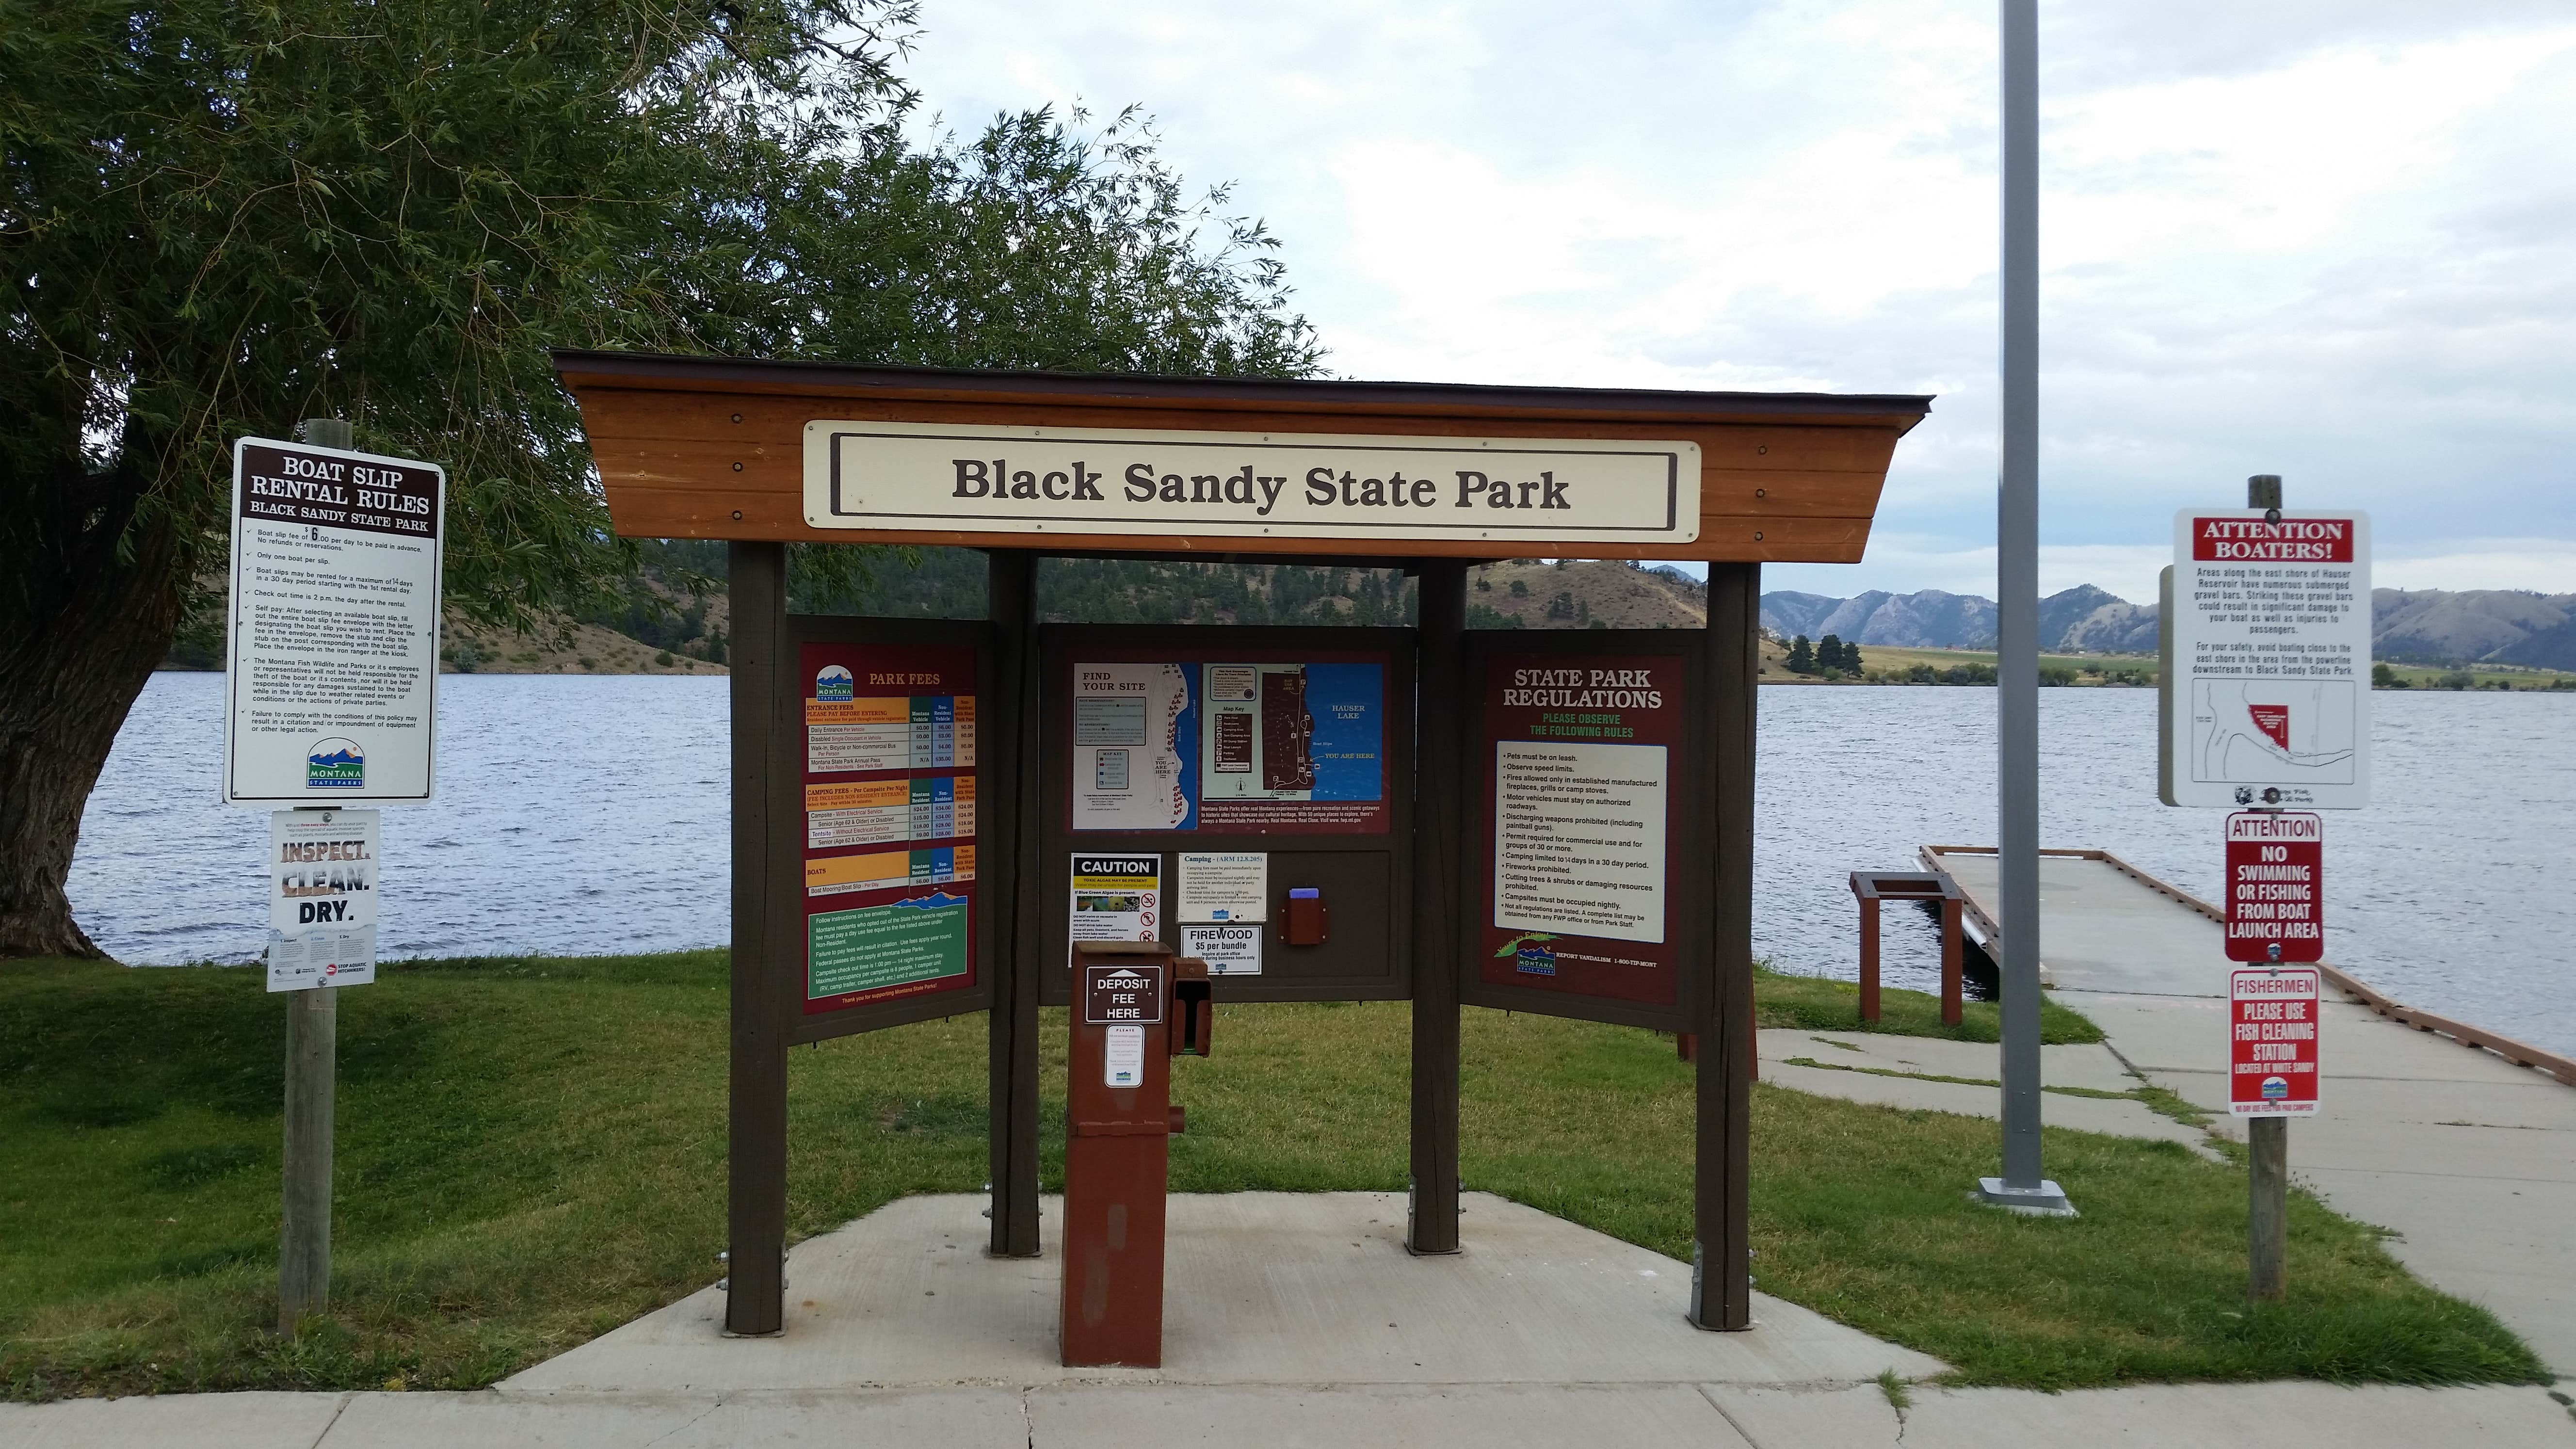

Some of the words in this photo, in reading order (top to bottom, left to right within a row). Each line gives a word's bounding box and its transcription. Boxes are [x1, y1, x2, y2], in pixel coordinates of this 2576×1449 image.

[283, 456, 344, 482] BOAT
[354, 467, 402, 489] SLIP
[952, 459, 1104, 500] Black
[1124, 464, 1287, 514] Sandy
[1305, 467, 1436, 507] State
[1455, 471, 1570, 509] Park
[251, 475, 348, 505] RENTAL
[357, 489, 429, 515] RULES
[250, 500, 296, 516] BLACK
[301, 507, 347, 522] SANDY
[352, 513, 390, 527] STATE
[395, 518, 428, 531] PARK
[2204, 521, 2343, 540] ATTENTION
[258, 529, 273, 539] Boat
[275, 531, 286, 540] slip
[343, 538, 354, 547] day
[397, 545, 422, 553] advance.
[269, 538, 293, 547] refunds
[304, 543, 343, 551] reservations.
[257, 551, 272, 560] Only
[2216, 542, 2332, 559] BOATERS!
[2197, 568, 2220, 577] Areas
[2224, 568, 2245, 578] along
[2249, 568, 2261, 578] the
[2265, 569, 2282, 578] east
[2286, 569, 2308, 578] shore
[2311, 569, 2319, 578] of
[2322, 569, 2351, 579] Hauser
[870, 674, 905, 684] PARK
[909, 674, 939, 684] FEES
[1082, 672, 1111, 680] FIND
[1515, 669, 1582, 687] STATE
[1590, 670, 1651, 688] PARK
[1082, 682, 1115, 691] YOUR
[1119, 682, 1145, 691] SITE
[1504, 689, 1661, 708] REGULATIONS
[1544, 713, 1575, 724] PLEASE
[1579, 713, 1620, 724] OBSERVE
[1530, 725, 1546, 735] THE
[1550, 725, 1601, 737] FOLLOWING
[1604, 727, 1633, 738] RULES
[1507, 763, 1533, 771] Observe
[2233, 819, 2315, 837] ATTENTION
[281, 840, 370, 863] INSPECT.
[2262, 846, 2287, 862] NO
[1082, 861, 1149, 872] CAUTION
[1505, 862, 1536, 871] Fireworks
[1537, 866, 1571, 874] prohibited.
[2238, 865, 2310, 881] SWIMMING
[282, 869, 369, 898] CLEAN.
[2237, 884, 2255, 900] OR
[2259, 884, 2310, 900] FISHING
[1505, 892, 1538, 902] Campsites
[1566, 899, 1595, 907] occupied
[1597, 901, 1621, 910] nightly.
[300, 900, 354, 924] DRY.
[2238, 903, 2274, 919] FROM
[2278, 903, 2311, 919] BOAT
[1191, 930, 1252, 940] FIREWOOD
[2229, 922, 2281, 938] LAUNCH
[2285, 922, 2319, 938] AREA
[1195, 942, 1205, 951] $5
[1207, 943, 1220, 952] per
[1222, 941, 1247, 950] bundle
[1519, 960, 1554, 968] MONTANA
[1579, 954, 1611, 963] VANDALISM
[1614, 958, 1657, 968] 1-800-TIP-MONT
[1098, 979, 1150, 989] DEPOSIT
[2237, 980, 2312, 994] FISHERMEN
[871, 990, 894, 999] supporting
[1113, 994, 1135, 1004] FEE
[1107, 1008, 1140, 1018] HERE
[2244, 1002, 2283, 1020] PLEASE
[2286, 1002, 2305, 1019] USE
[2236, 1023, 2259, 1041] FISH
[2262, 1023, 2314, 1040] CLEANING
[2254, 1043, 2296, 1061] STATION
